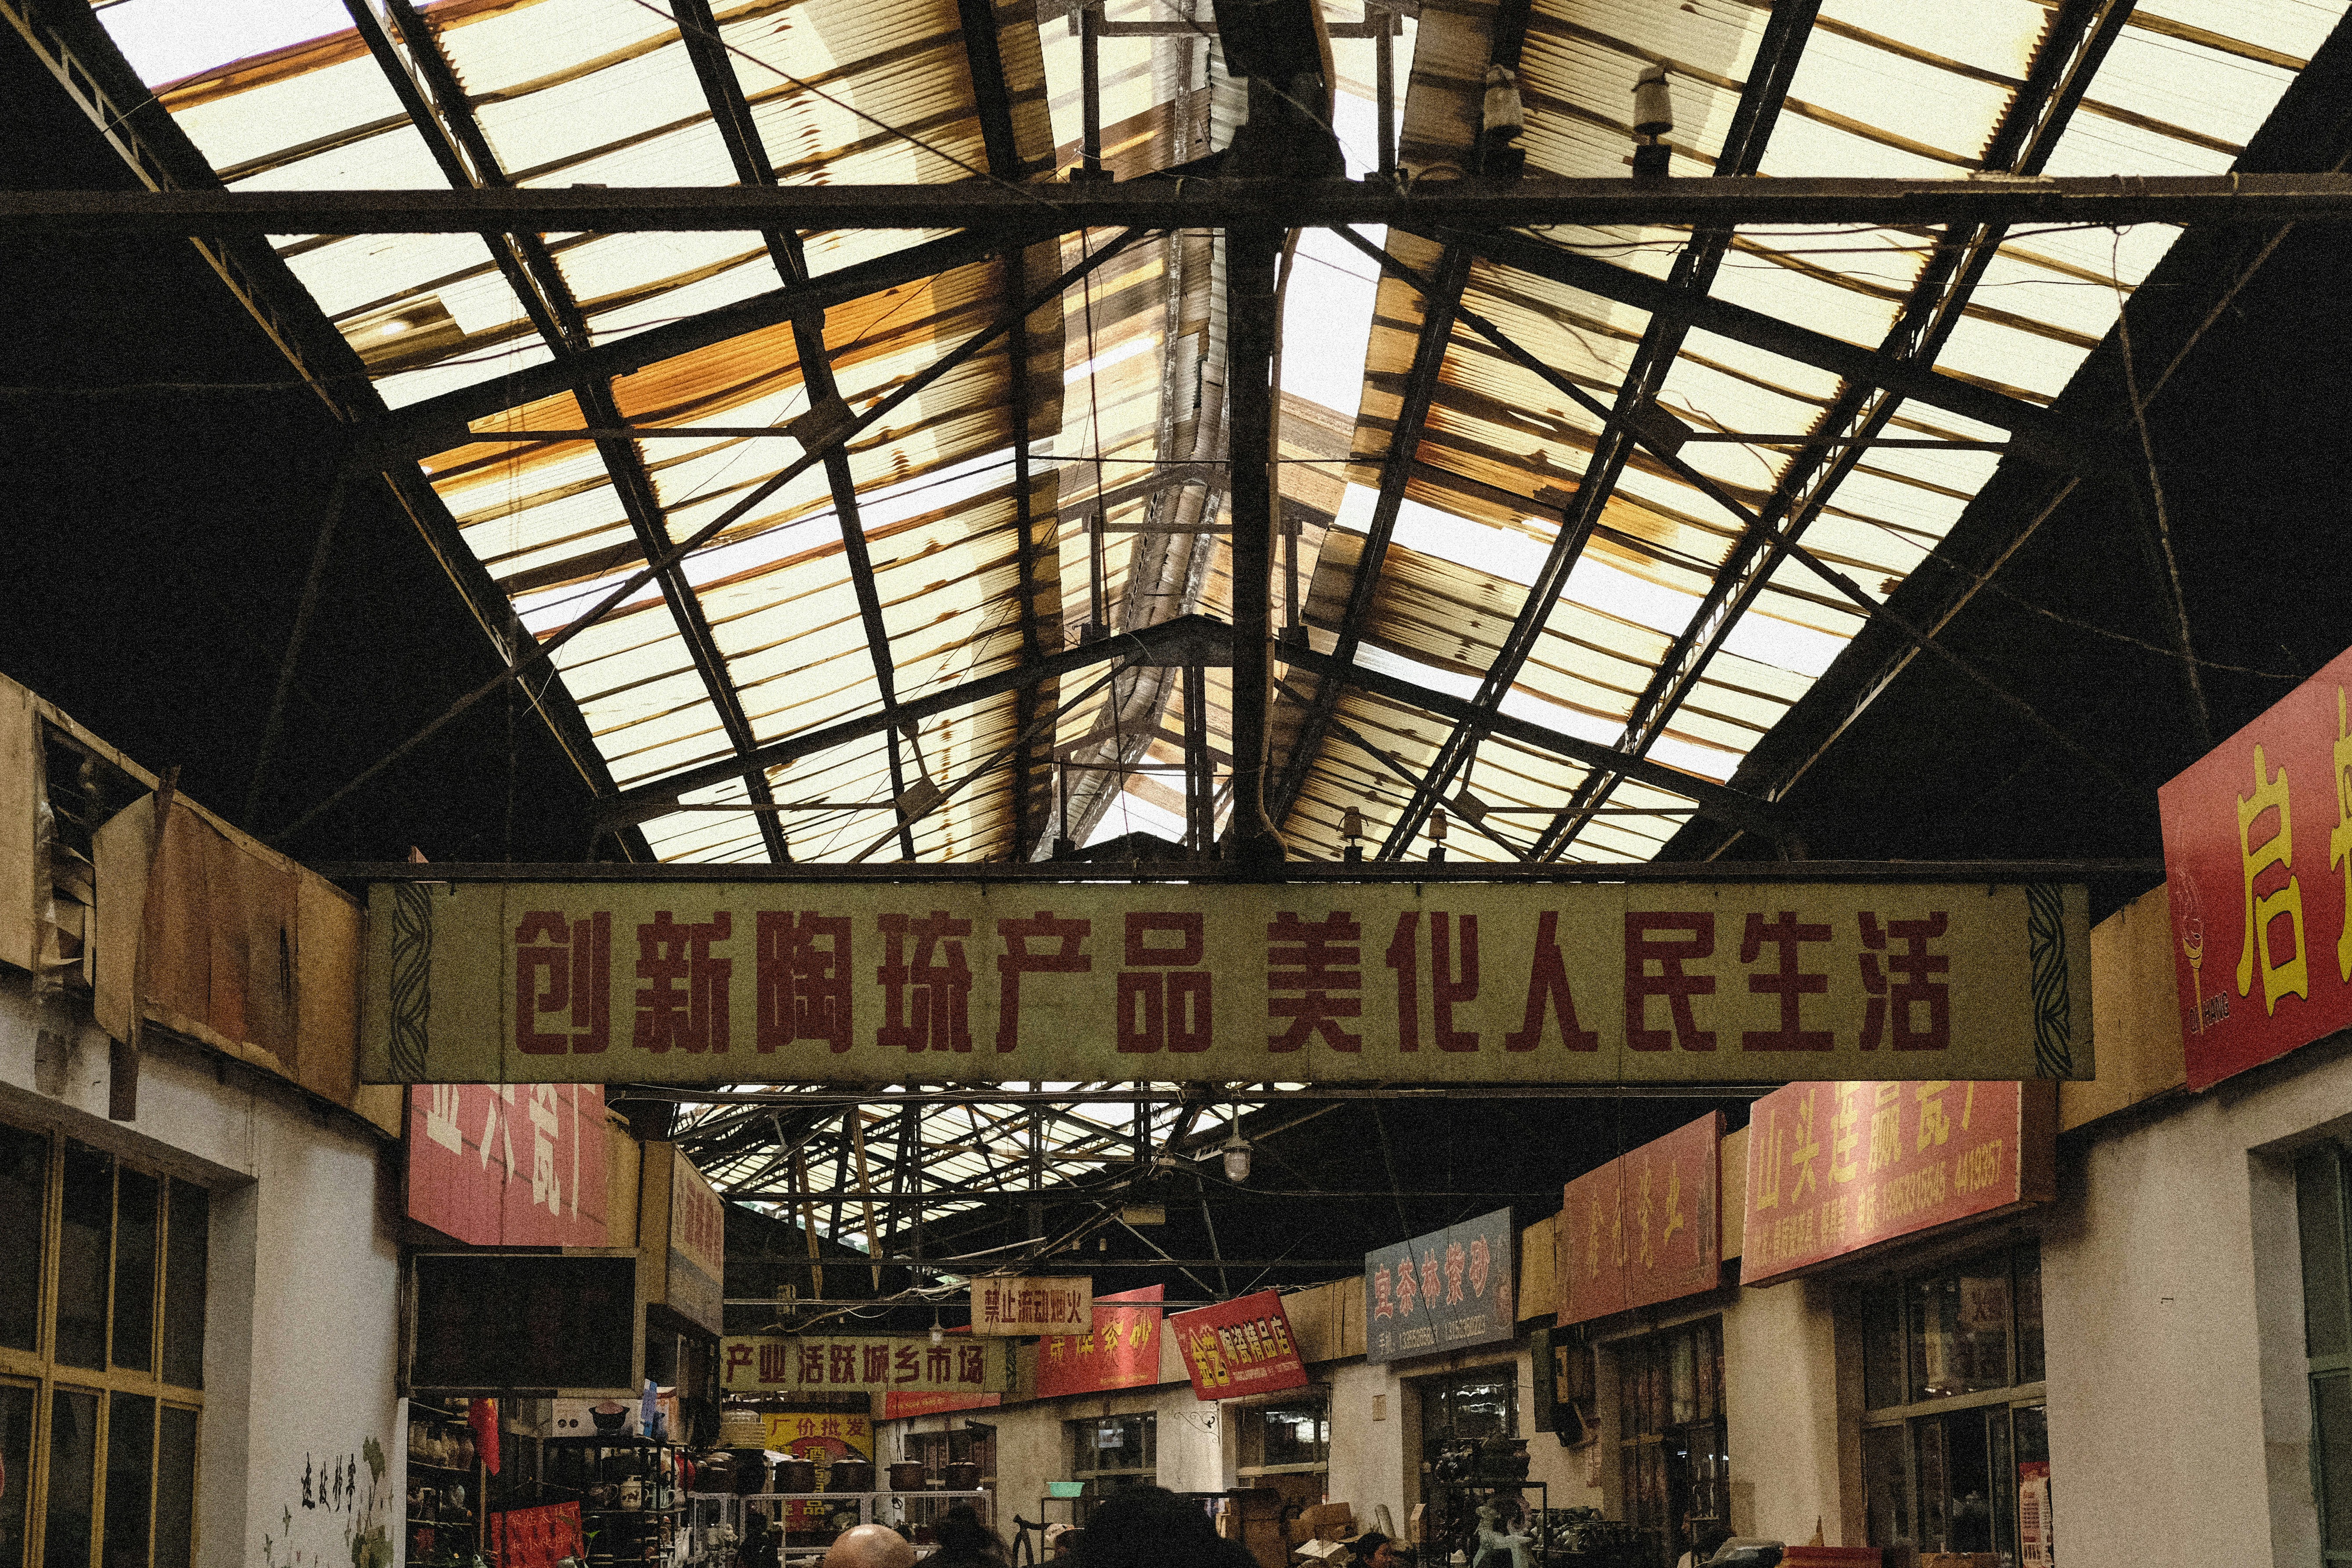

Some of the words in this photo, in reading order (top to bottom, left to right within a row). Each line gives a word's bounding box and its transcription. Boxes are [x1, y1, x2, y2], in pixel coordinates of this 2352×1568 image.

[515, 910, 1212, 1055] 创新陶琉产品
[1266, 910, 1950, 1053] 美化人民生活
[984, 1289, 1082, 1324] 禁止流动烟火
[726, 1343, 786, 1383] 产业
[797, 1343, 984, 1384] 活跃城乡市场
[771, 1417, 865, 1437] 厂价批发
